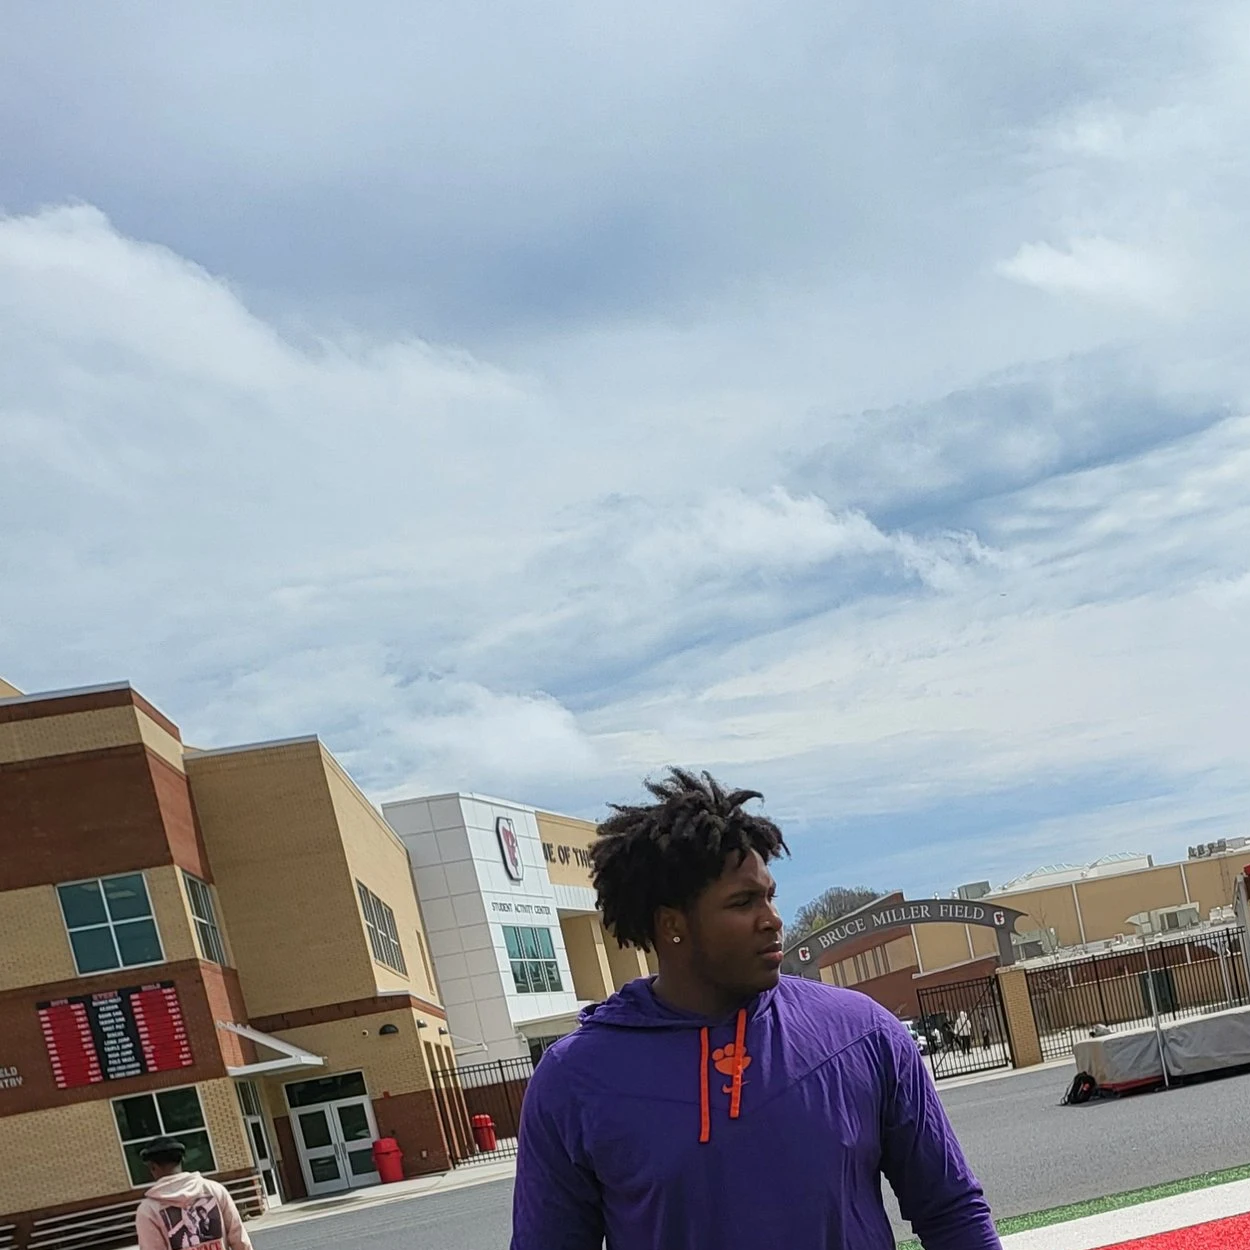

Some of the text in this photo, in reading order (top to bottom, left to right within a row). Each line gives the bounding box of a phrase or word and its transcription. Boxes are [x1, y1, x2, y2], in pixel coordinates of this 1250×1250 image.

[558, 845, 570, 865] OF
[491, 902, 551, 915] STUDENT ACTIVITY CENTER
[817, 904, 985, 949] BRUCE MILLER FIELD
